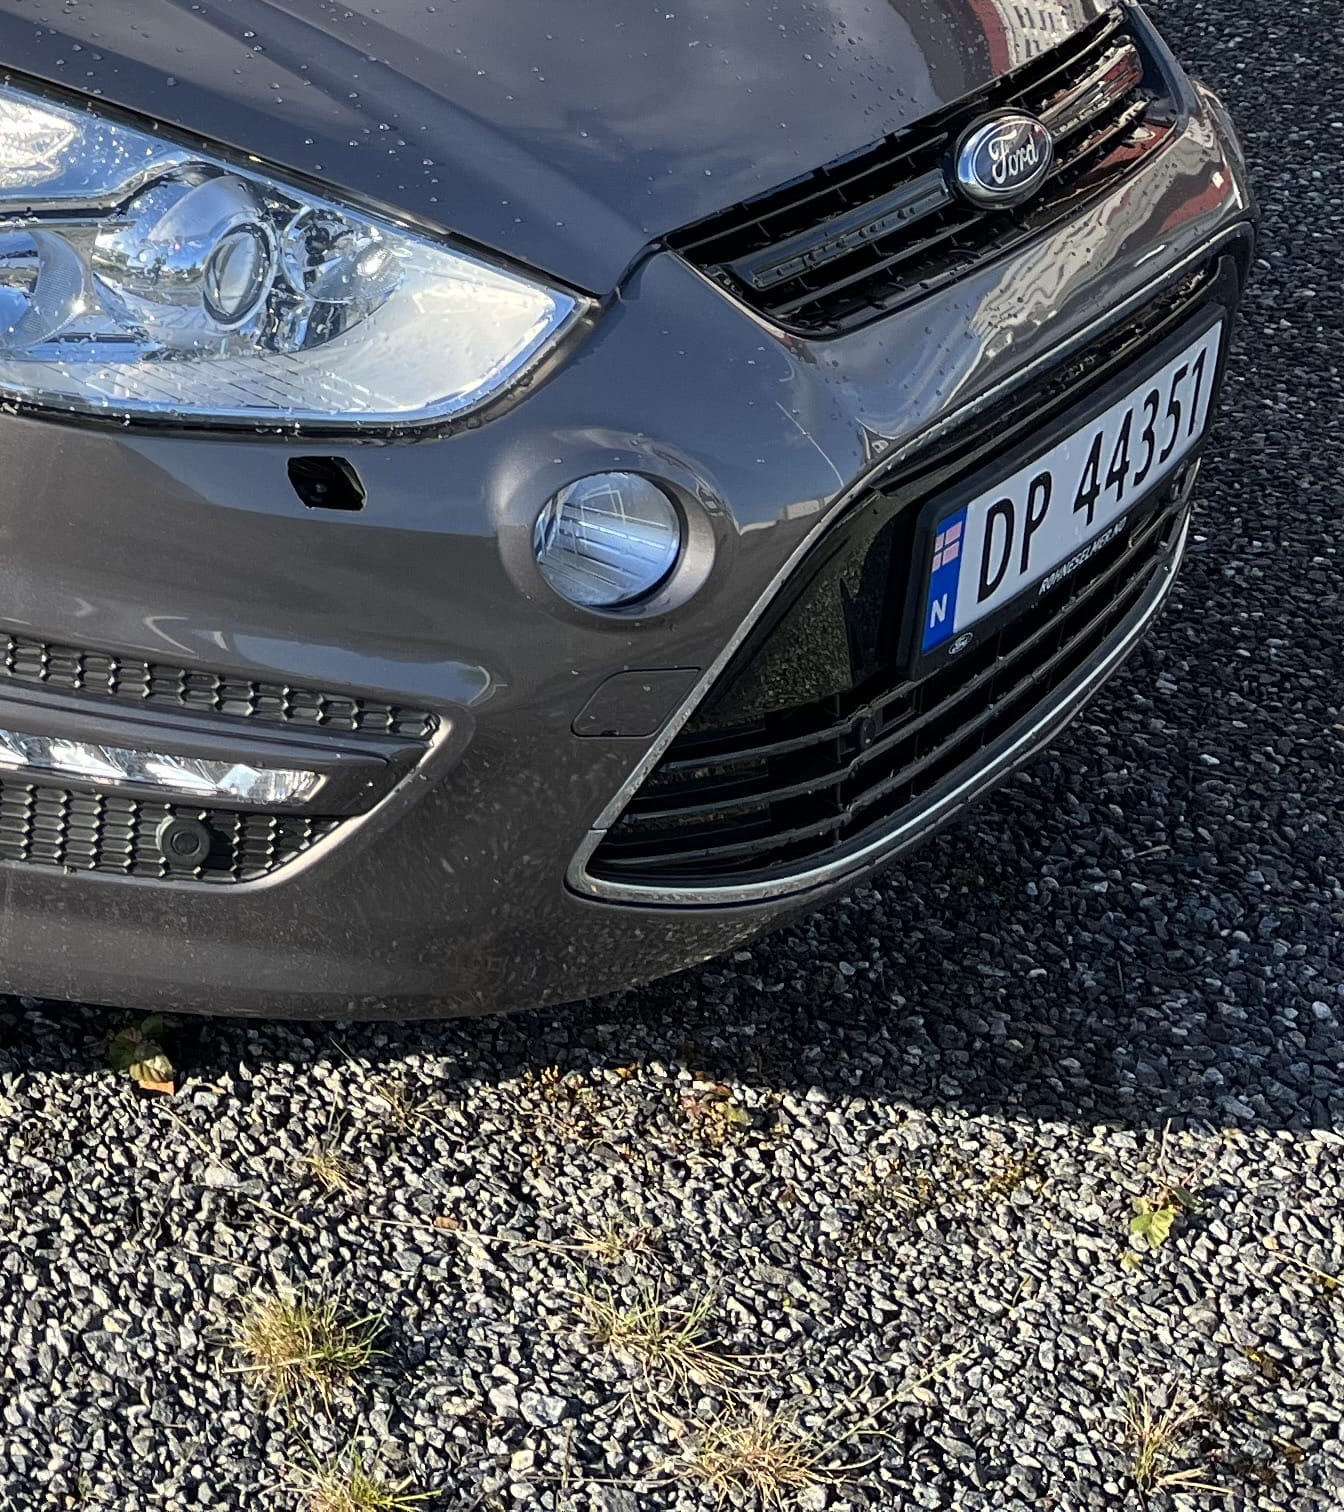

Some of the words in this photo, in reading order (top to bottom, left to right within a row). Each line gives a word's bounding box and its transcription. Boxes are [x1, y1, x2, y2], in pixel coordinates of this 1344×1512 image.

[988, 128, 1040, 185] Ford
[976, 470, 1053, 604] DP
[1072, 346, 1208, 527] 44351
[929, 593, 948, 629] N
